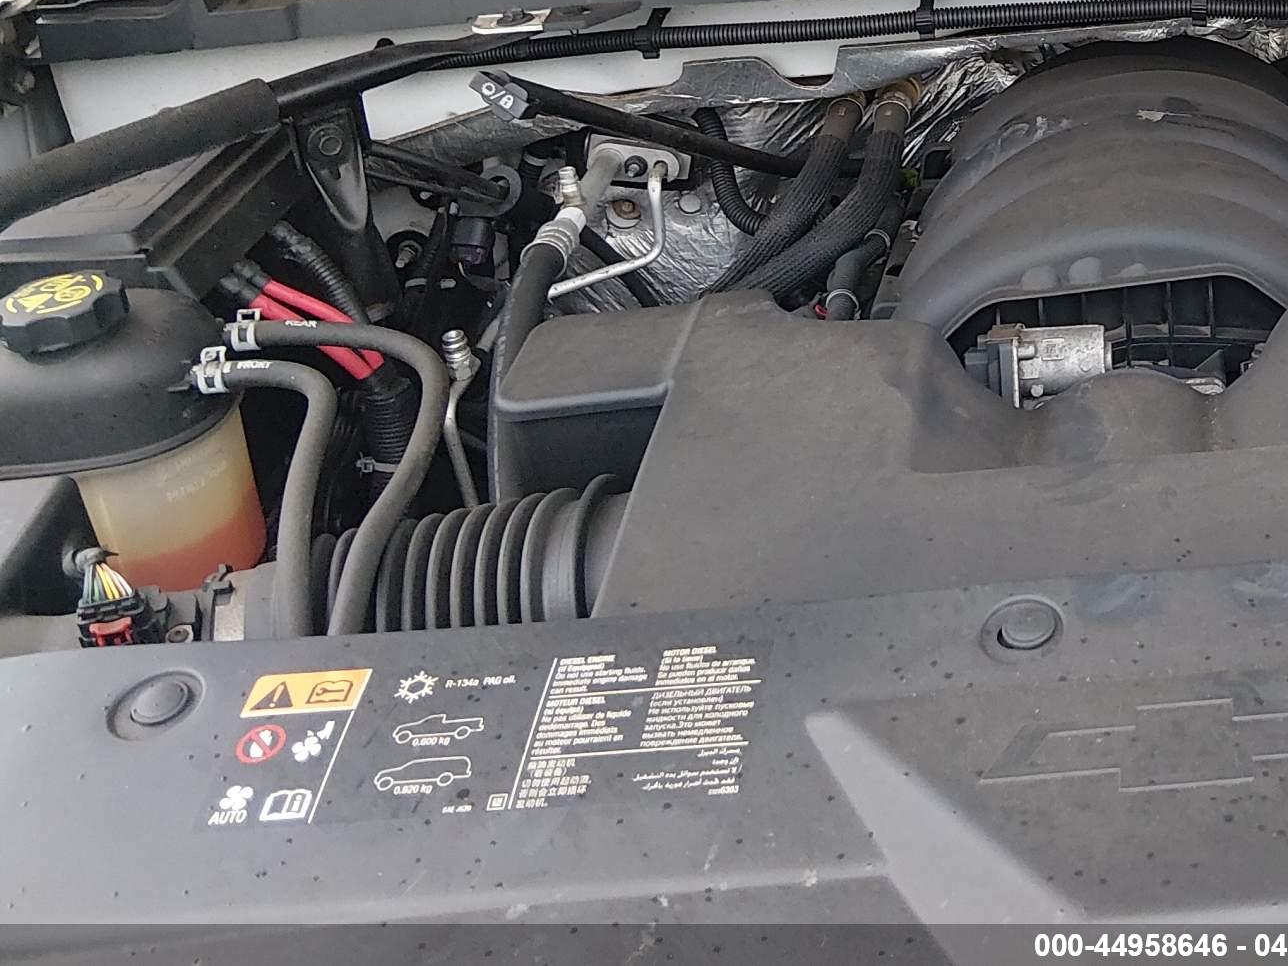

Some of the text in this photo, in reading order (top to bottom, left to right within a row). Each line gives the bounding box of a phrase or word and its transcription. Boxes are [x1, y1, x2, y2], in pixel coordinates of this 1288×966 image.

[237, 361, 272, 369] FRONT
[445, 678, 480, 688] R-134a
[420, 784, 432, 794] kg
[208, 810, 248, 825] AUTO
